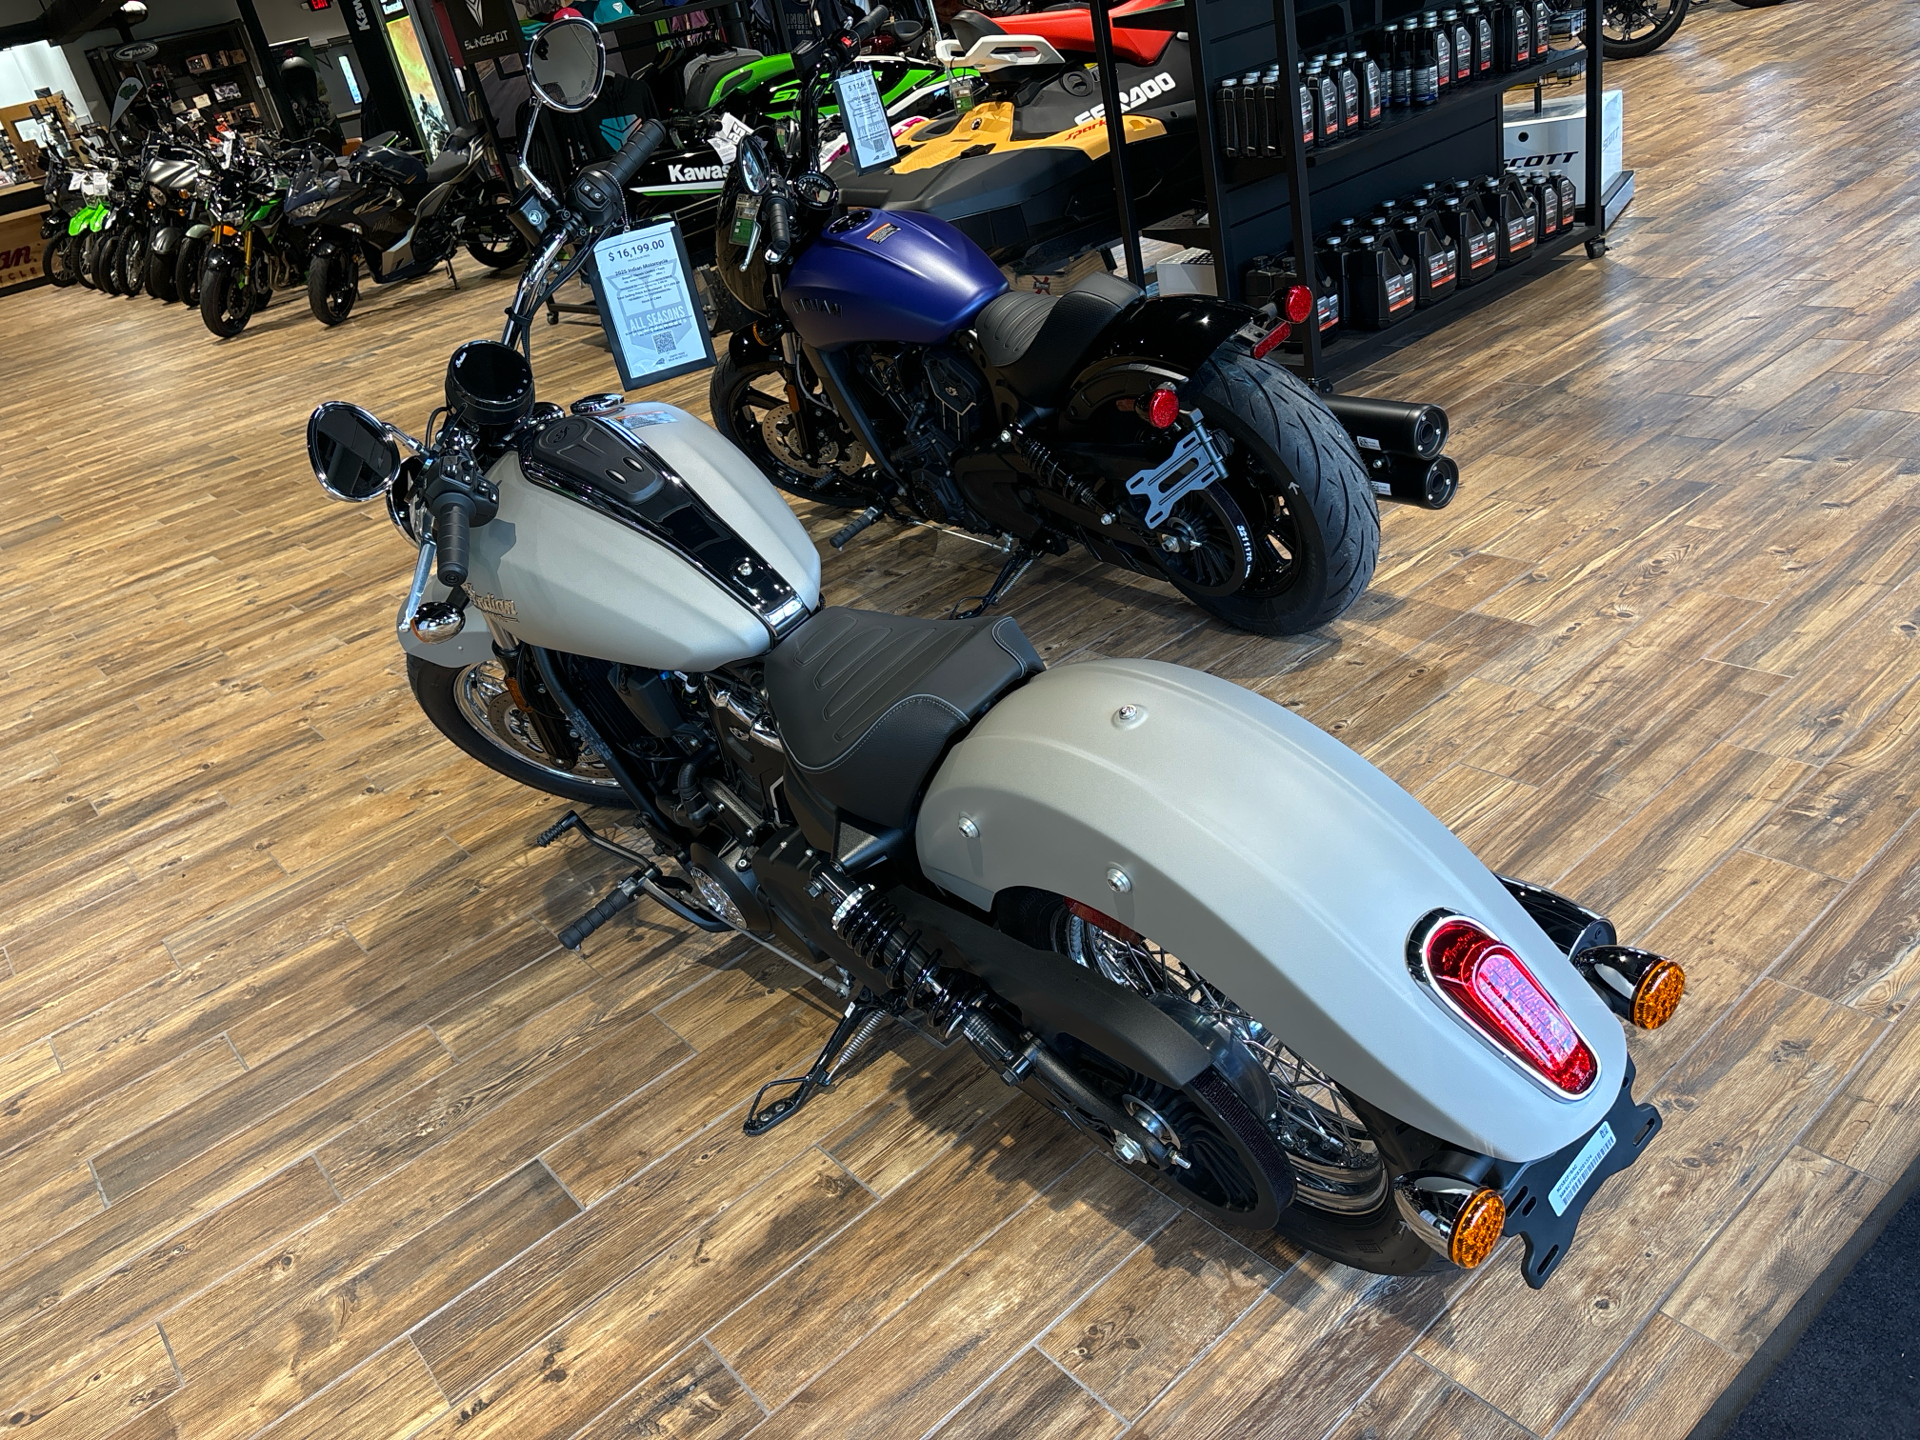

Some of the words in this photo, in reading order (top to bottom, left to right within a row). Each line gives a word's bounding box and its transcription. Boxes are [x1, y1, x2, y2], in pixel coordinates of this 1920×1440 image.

[464, 30, 509, 50] SLINGSHOT
[1504, 151, 1578, 168] SCOTT
[608, 252, 615, 262] $
[617, 239, 664, 258] 16,199.00
[642, 258, 668, 269] Motorcycle
[630, 316, 646, 332] ALL
[646, 305, 685, 326] SEASONS
[460, 582, 518, 616] Indian
